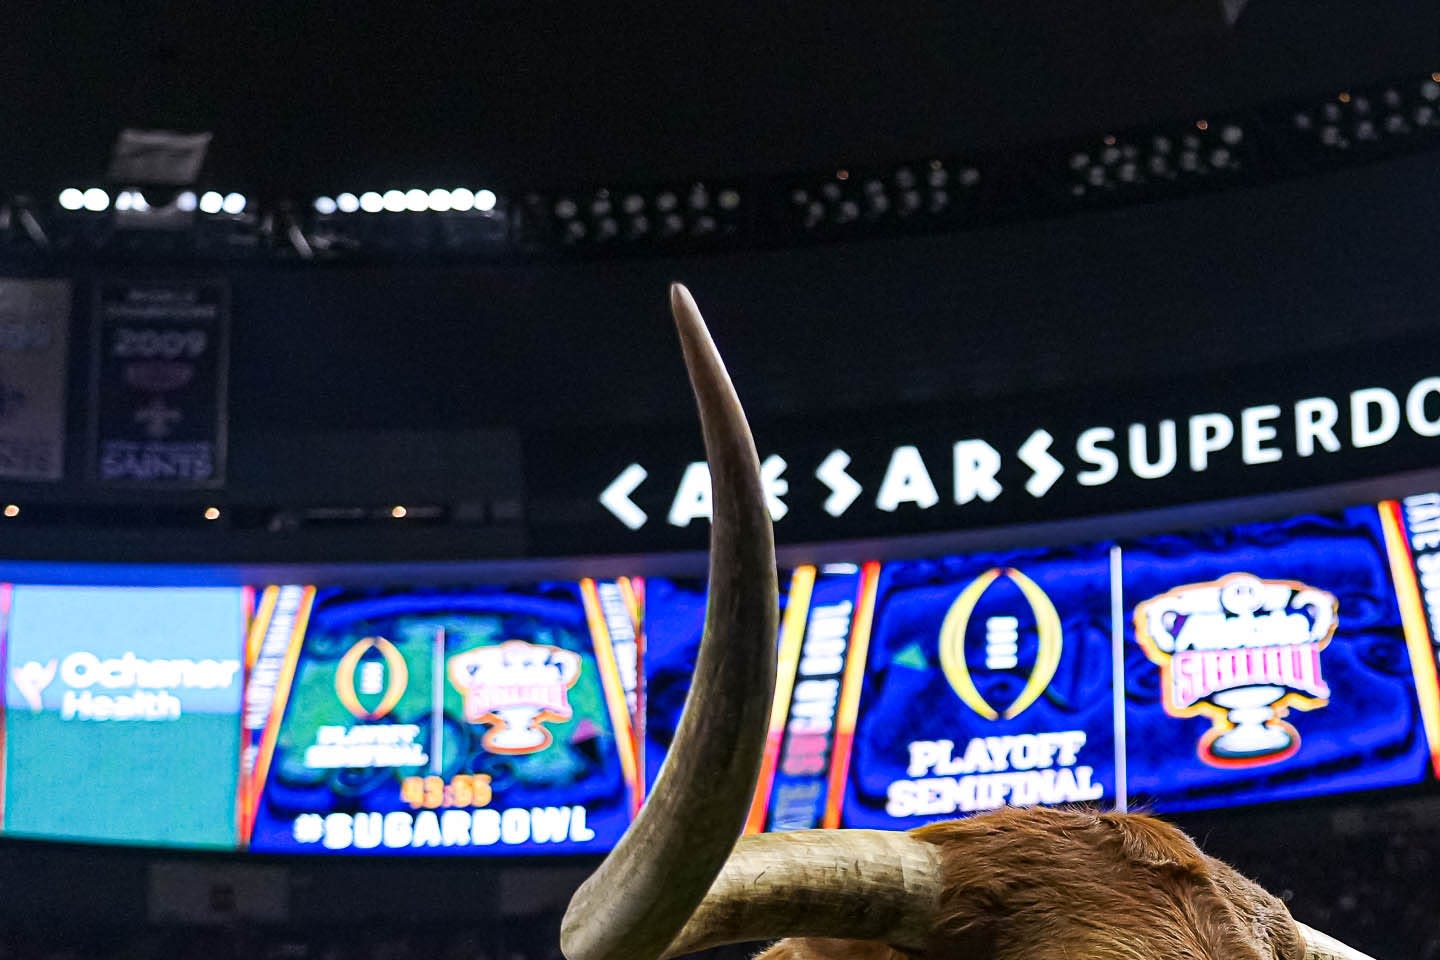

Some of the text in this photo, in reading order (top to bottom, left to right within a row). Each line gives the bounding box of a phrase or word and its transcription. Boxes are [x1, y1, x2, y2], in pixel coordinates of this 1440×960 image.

[907, 731, 1087, 777] PLAYOFF
[886, 766, 1104, 818] SEMIFINAL
[293, 805, 596, 850] #SUGARBOWL
